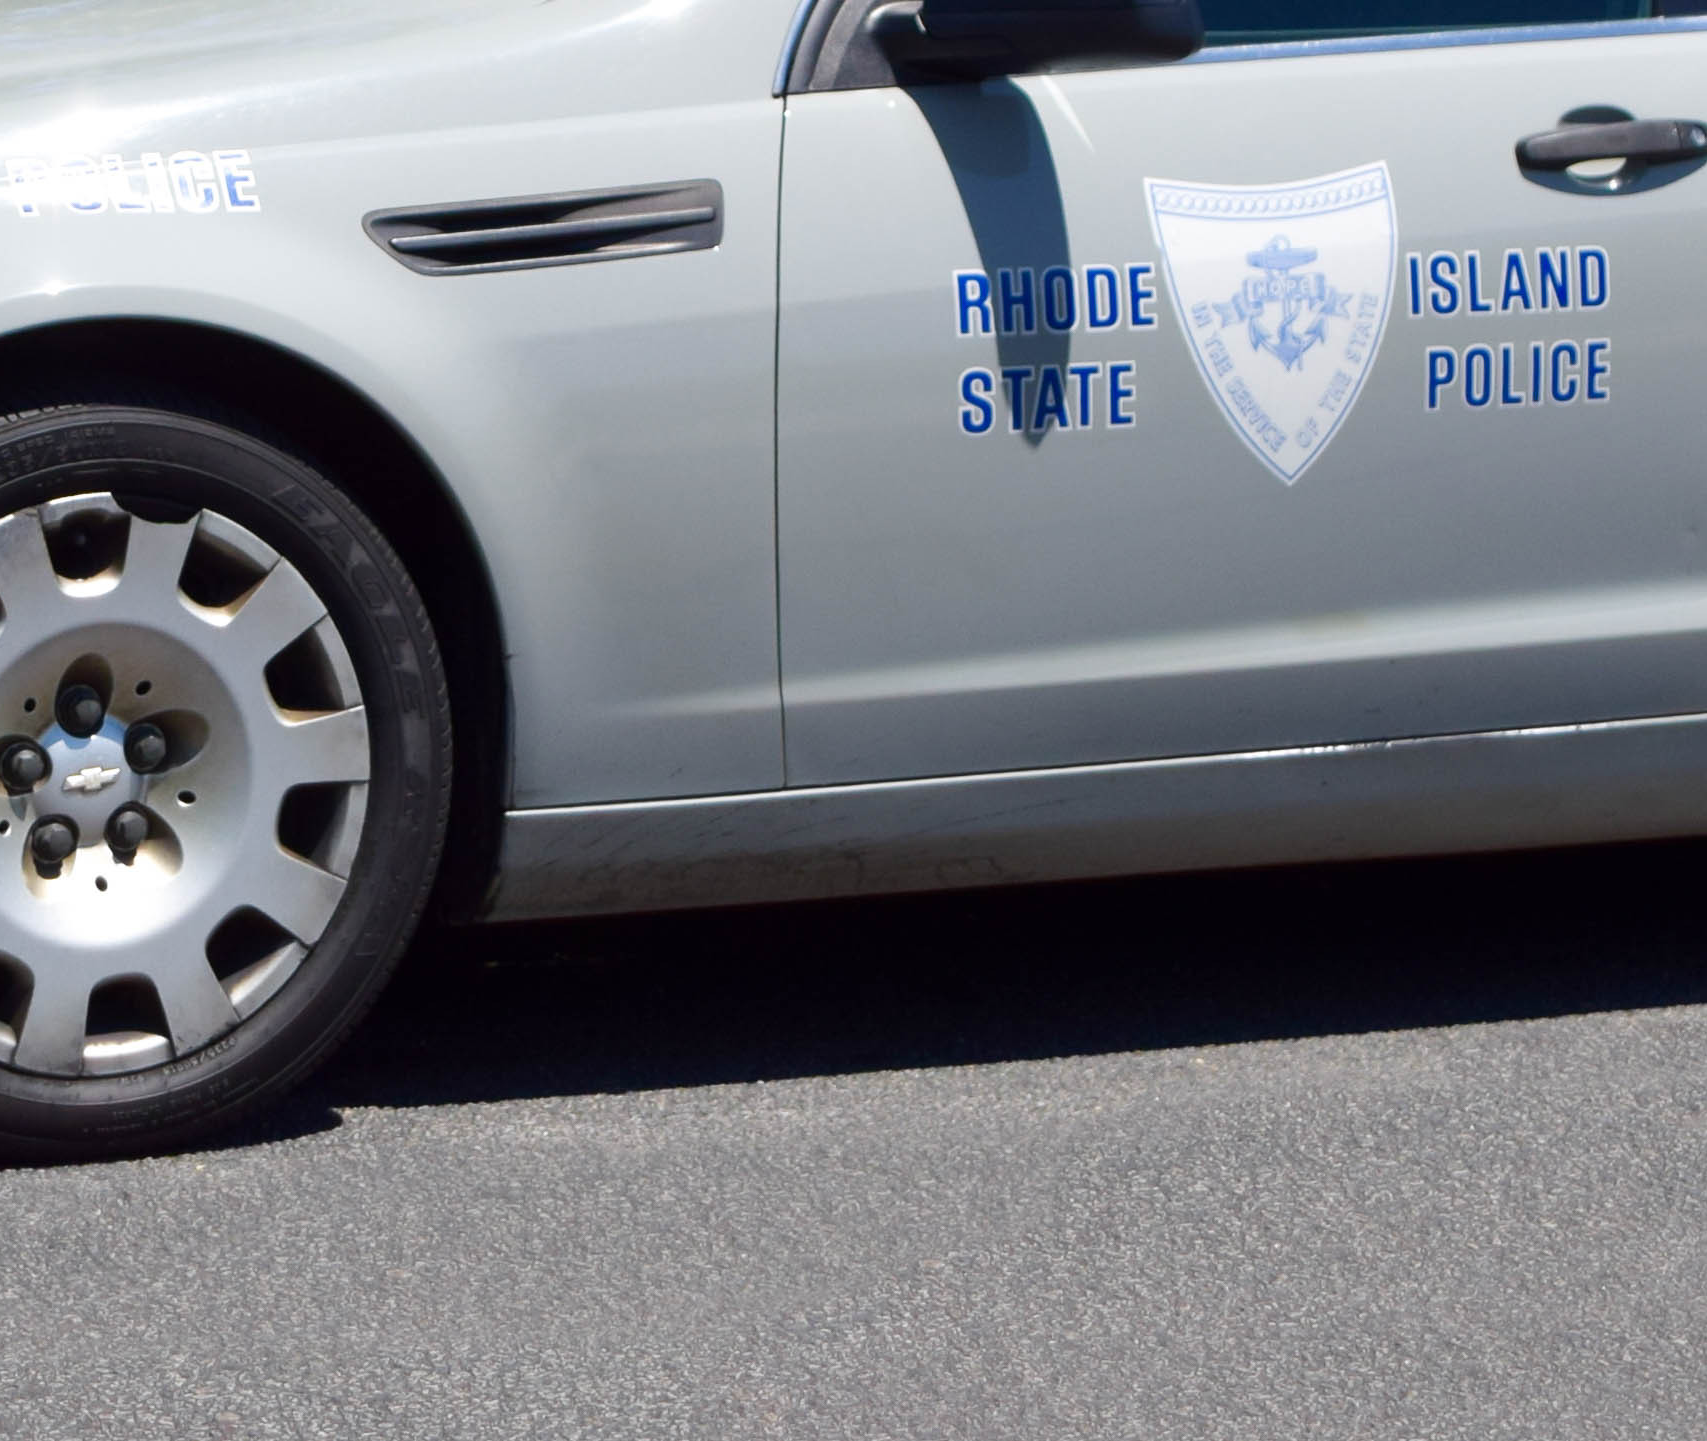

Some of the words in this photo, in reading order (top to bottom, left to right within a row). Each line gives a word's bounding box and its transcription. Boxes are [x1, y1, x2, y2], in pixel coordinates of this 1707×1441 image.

[7, 149, 261, 218] POLICE
[954, 263, 1157, 336] RHODE
[1406, 247, 1610, 316] ISLAND
[1256, 277, 1312, 299] HOPE
[958, 361, 1136, 435] STATE
[1425, 339, 1610, 410] POLICE
[1204, 333, 1235, 377] THE
[1226, 375, 1288, 454] SERVICE
[1296, 416, 1321, 449] OF
[1318, 368, 1354, 413] THE
[1345, 292, 1380, 364] STATE
[274, 482, 428, 719] EAGLE
